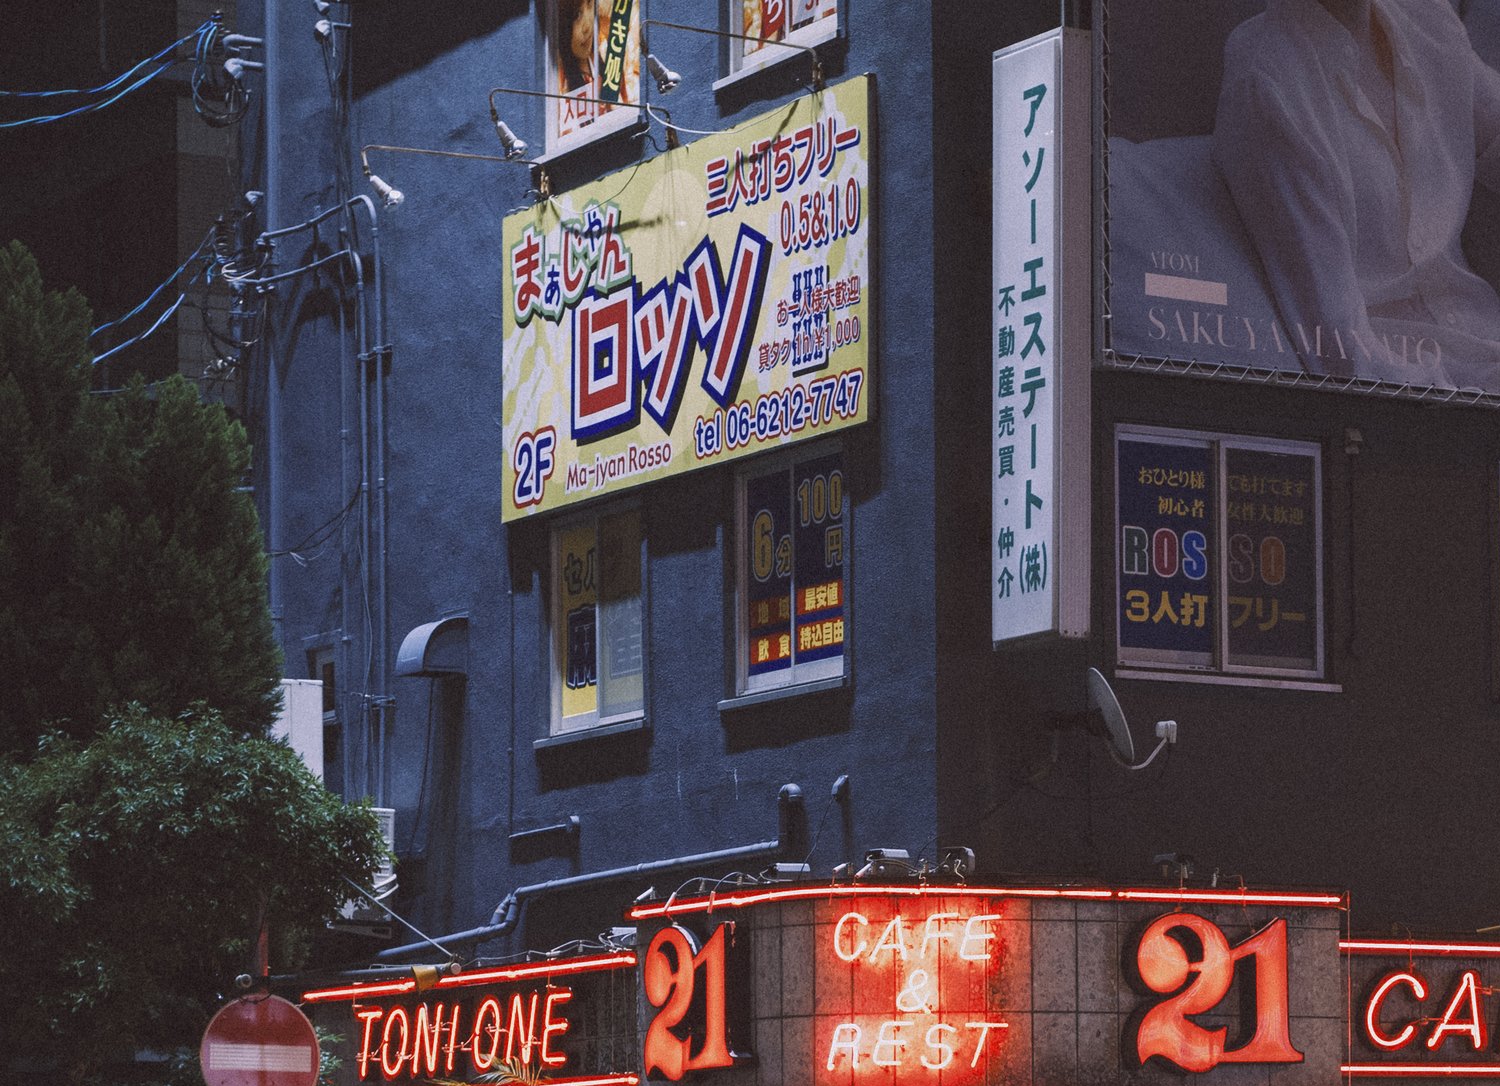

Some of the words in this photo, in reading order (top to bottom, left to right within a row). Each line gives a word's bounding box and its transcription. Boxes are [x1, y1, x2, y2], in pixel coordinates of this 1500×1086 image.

[706, 126, 860, 217] 三人打ちフリー
[780, 177, 859, 255] 0.5&1.0
[695, 412, 721, 457] tel
[724, 369, 864, 450] 06-6212-7747
[513, 426, 558, 509] 2F
[629, 441, 672, 472] Rosso
[833, 911, 1003, 962] CAFE
[473, 986, 573, 1074] ONE
[644, 920, 733, 1081] 21
[896, 968, 932, 1014] &
[1136, 911, 1305, 1073] 21
[826, 1021, 1009, 1073] REST
